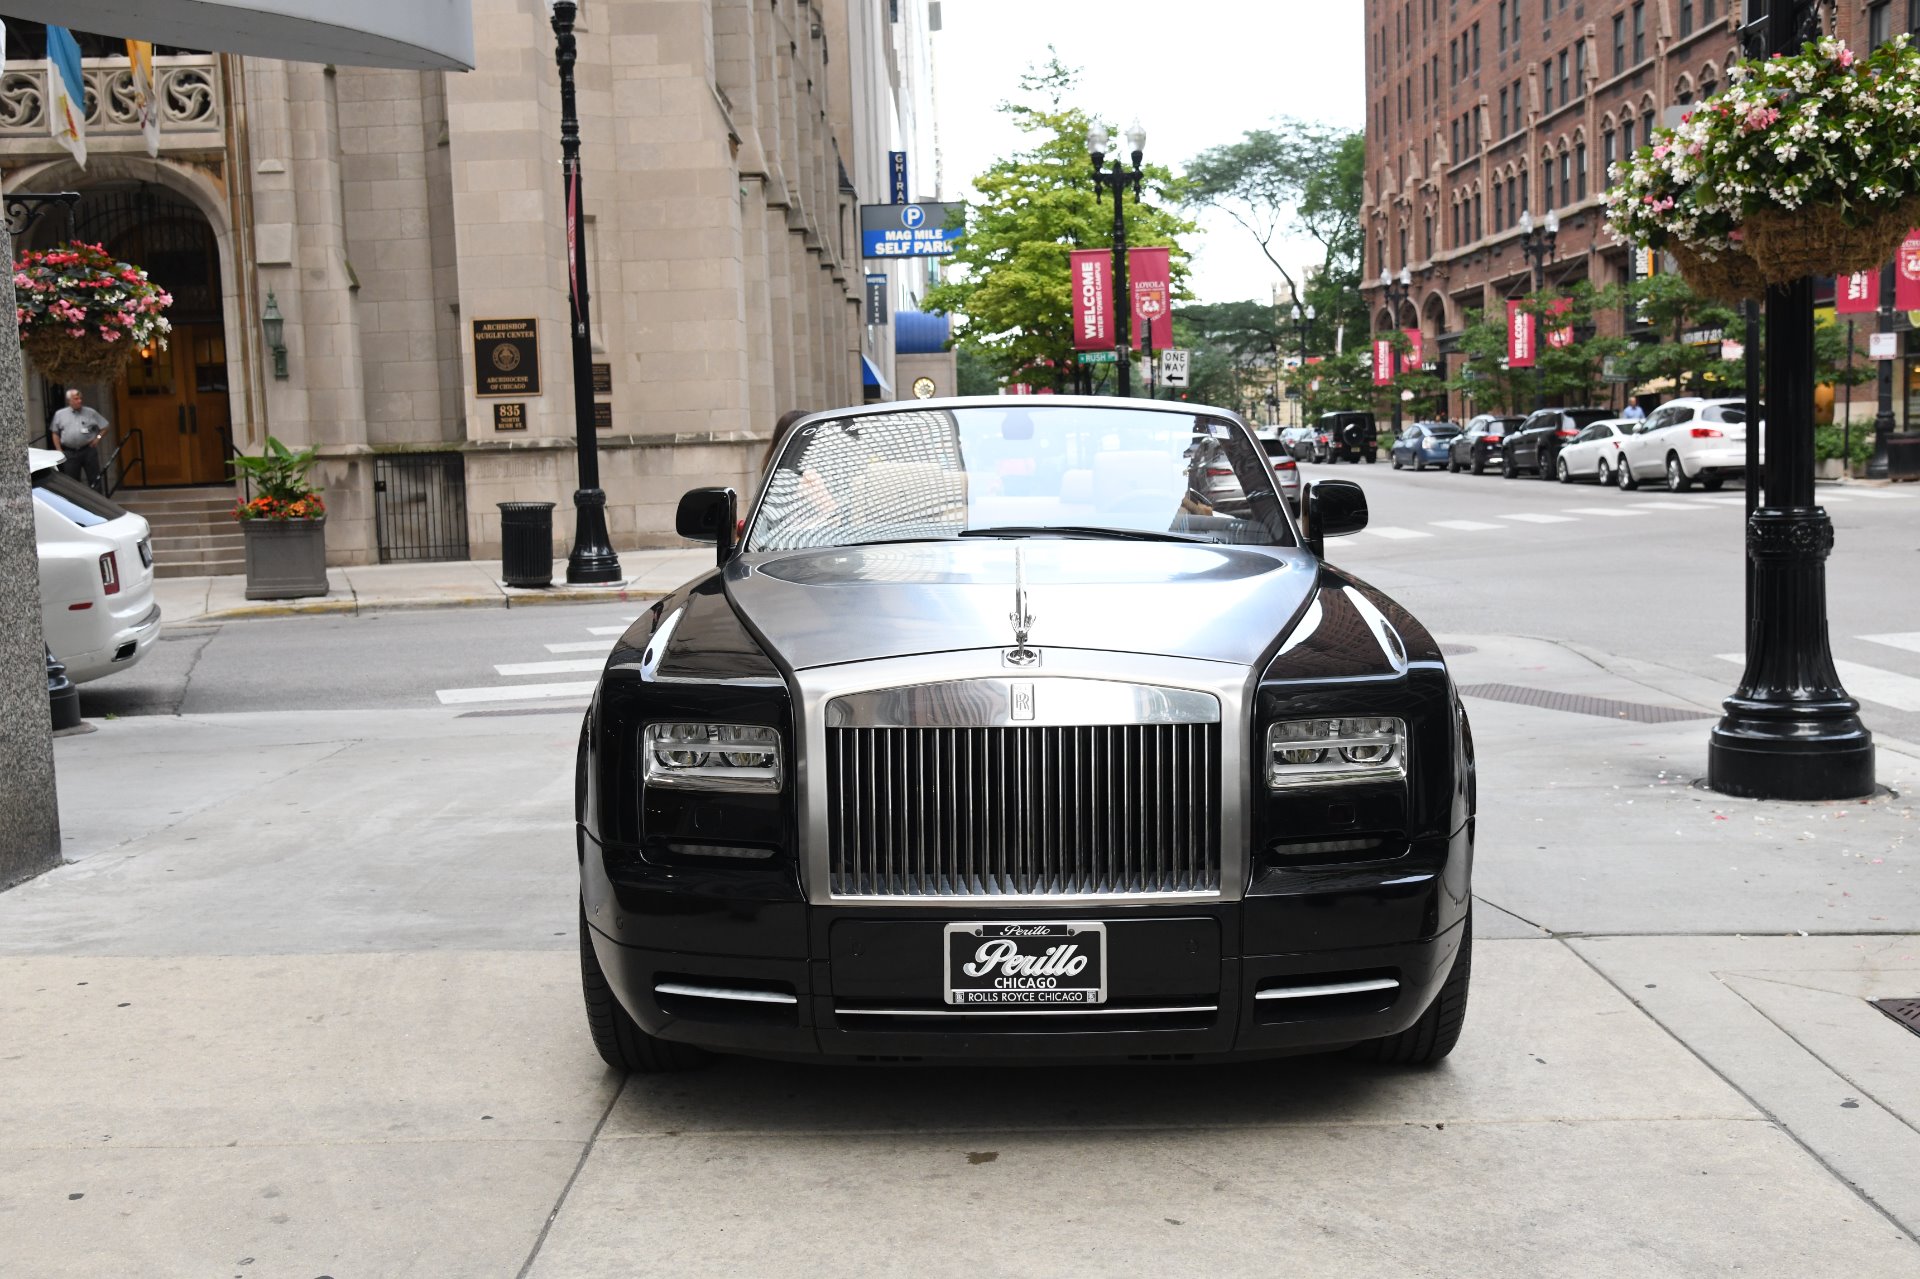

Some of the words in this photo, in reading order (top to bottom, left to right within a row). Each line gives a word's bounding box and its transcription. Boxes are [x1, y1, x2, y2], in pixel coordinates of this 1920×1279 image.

[885, 230, 911, 241] MAG
[914, 229, 943, 240] MILE
[875, 242, 910, 255] SELF
[914, 241, 953, 253] PARK
[1094, 262, 1102, 290] CAMPUS
[1135, 281, 1165, 289] LOYOLA
[1081, 261, 1096, 339] WELCOME
[482, 322, 527, 331] ARCHBISHOP
[475, 332, 506, 340] QUIGLEY
[507, 331, 534, 339] CENTER
[1086, 352, 1106, 362] RUSH
[1165, 352, 1185, 362] ONE
[1165, 363, 1185, 372] WAY
[499, 405, 520, 417] 835
[999, 924, 1051, 936] Perillo
[963, 939, 1088, 977] Perillo
[994, 977, 1057, 989] CHICAGO
[968, 992, 998, 1001] ROLLS
[1001, 992, 1035, 1001] ROYCE
[1038, 992, 1083, 1001] CHICAGO
